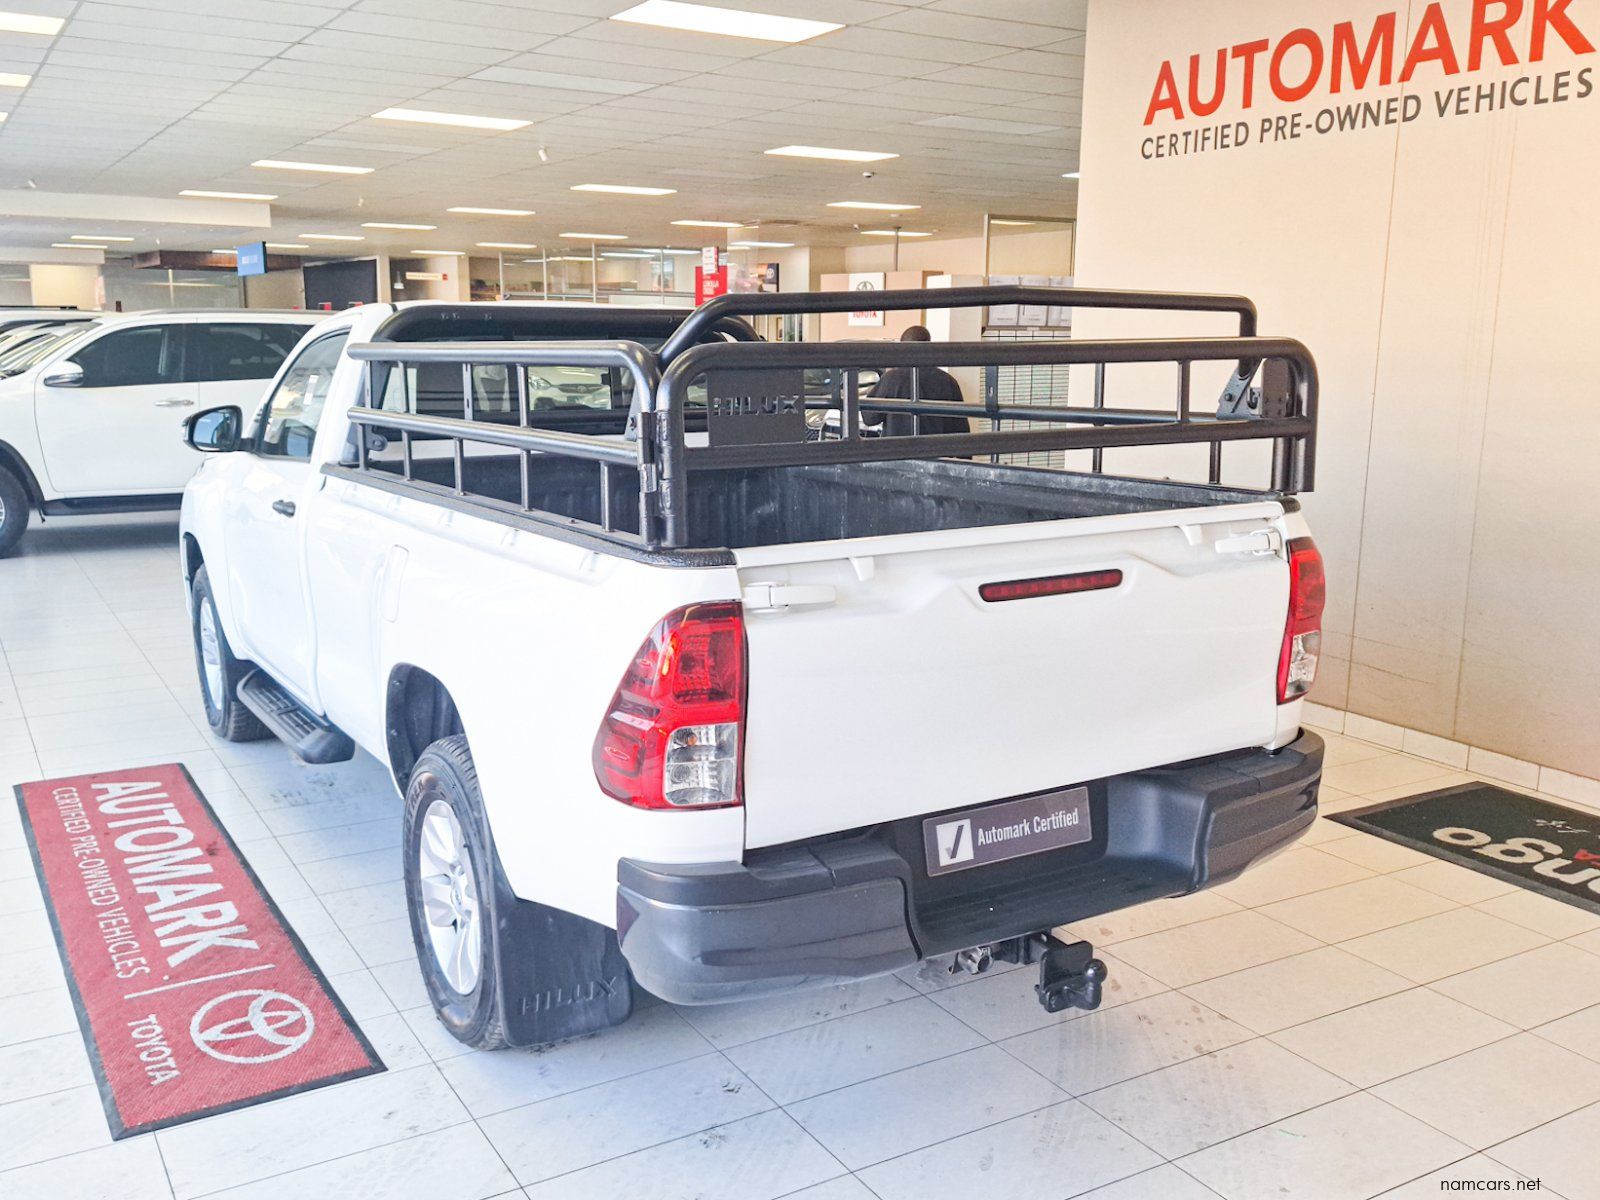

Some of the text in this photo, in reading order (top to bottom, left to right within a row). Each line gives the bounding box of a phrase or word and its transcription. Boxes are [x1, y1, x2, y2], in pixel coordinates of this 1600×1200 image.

[1144, 0, 1597, 126] AUTOMARK
[1141, 67, 1594, 160] CERTIFIED PRE-OWNED VEHICLES
[711, 395, 800, 417] HILUX
[977, 807, 1080, 846] Automark Certified
[52, 786, 151, 979] CERTIFIED PRE-OWNED VEHICLES
[91, 781, 260, 968] AUTOMARK
[521, 976, 618, 1017] HILUX
[127, 1013, 181, 1087] TOYOTA
